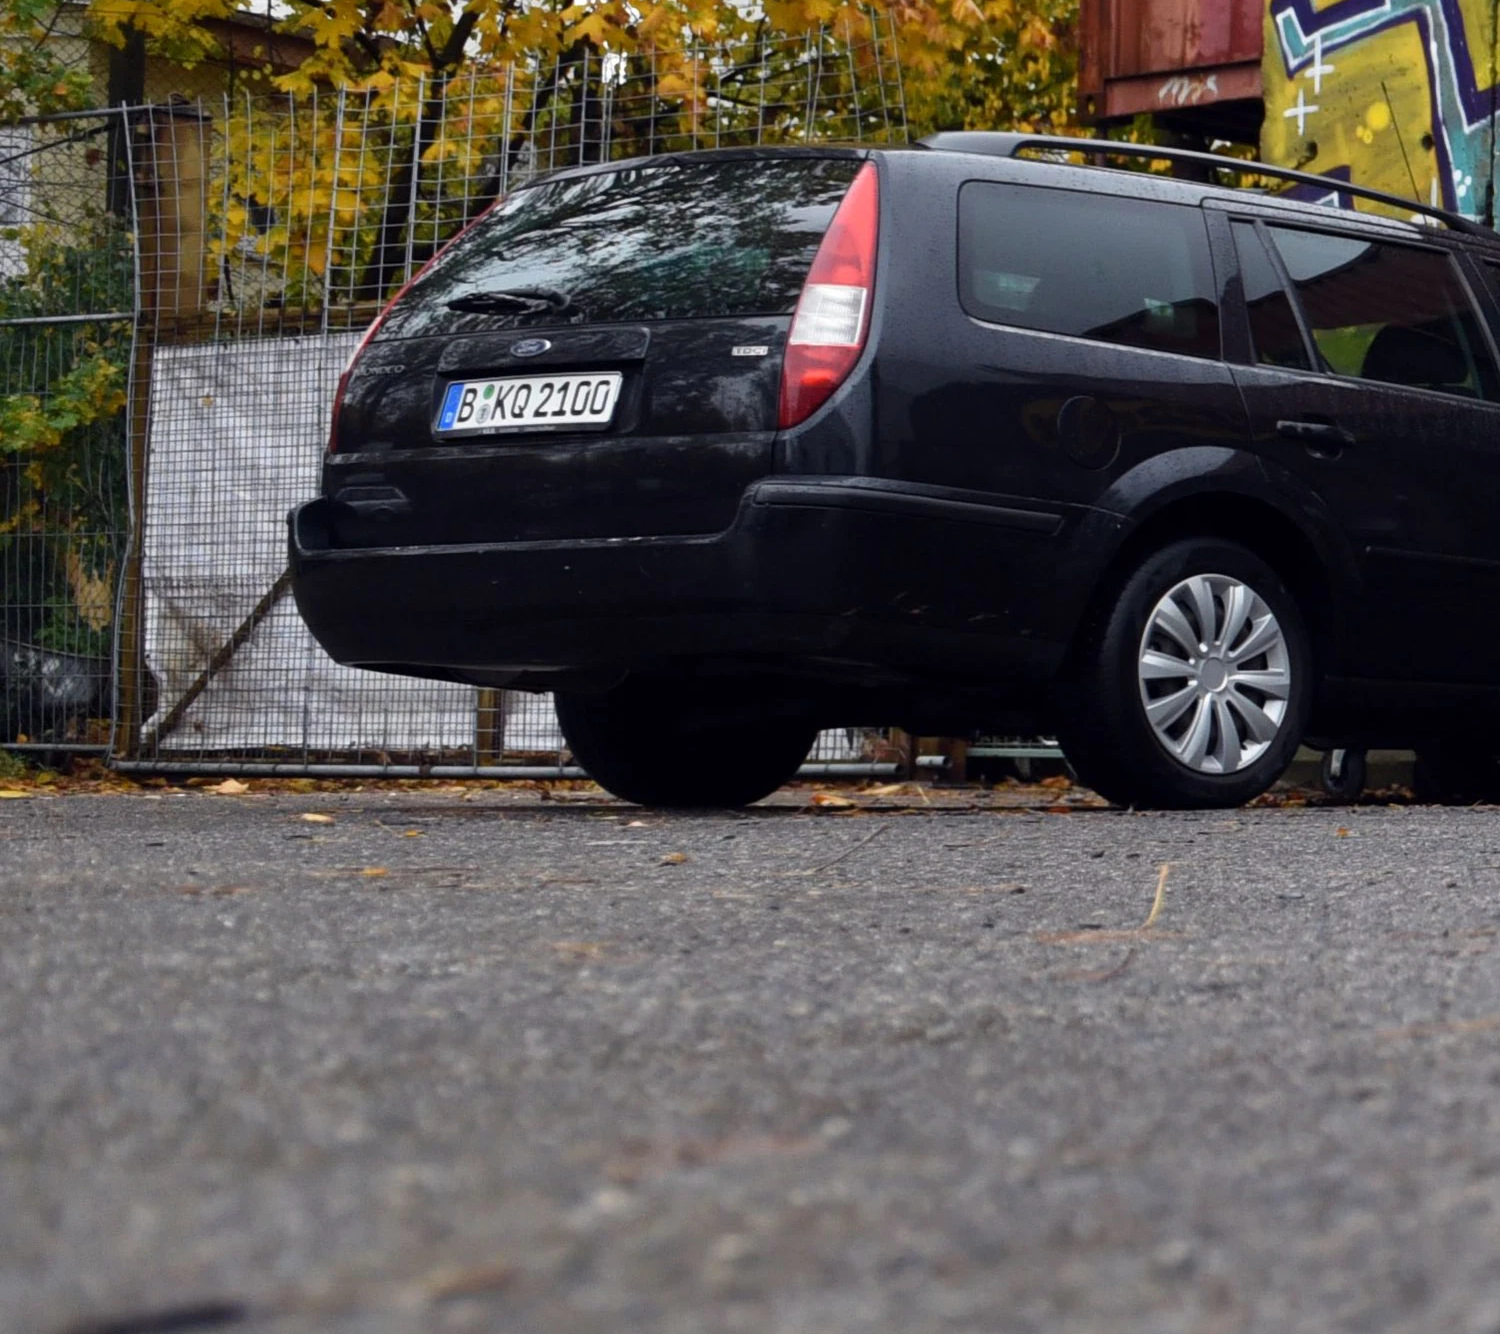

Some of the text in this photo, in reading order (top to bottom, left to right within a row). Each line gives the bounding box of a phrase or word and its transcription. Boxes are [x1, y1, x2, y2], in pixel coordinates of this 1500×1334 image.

[457, 379, 611, 423] B KQ 2100
